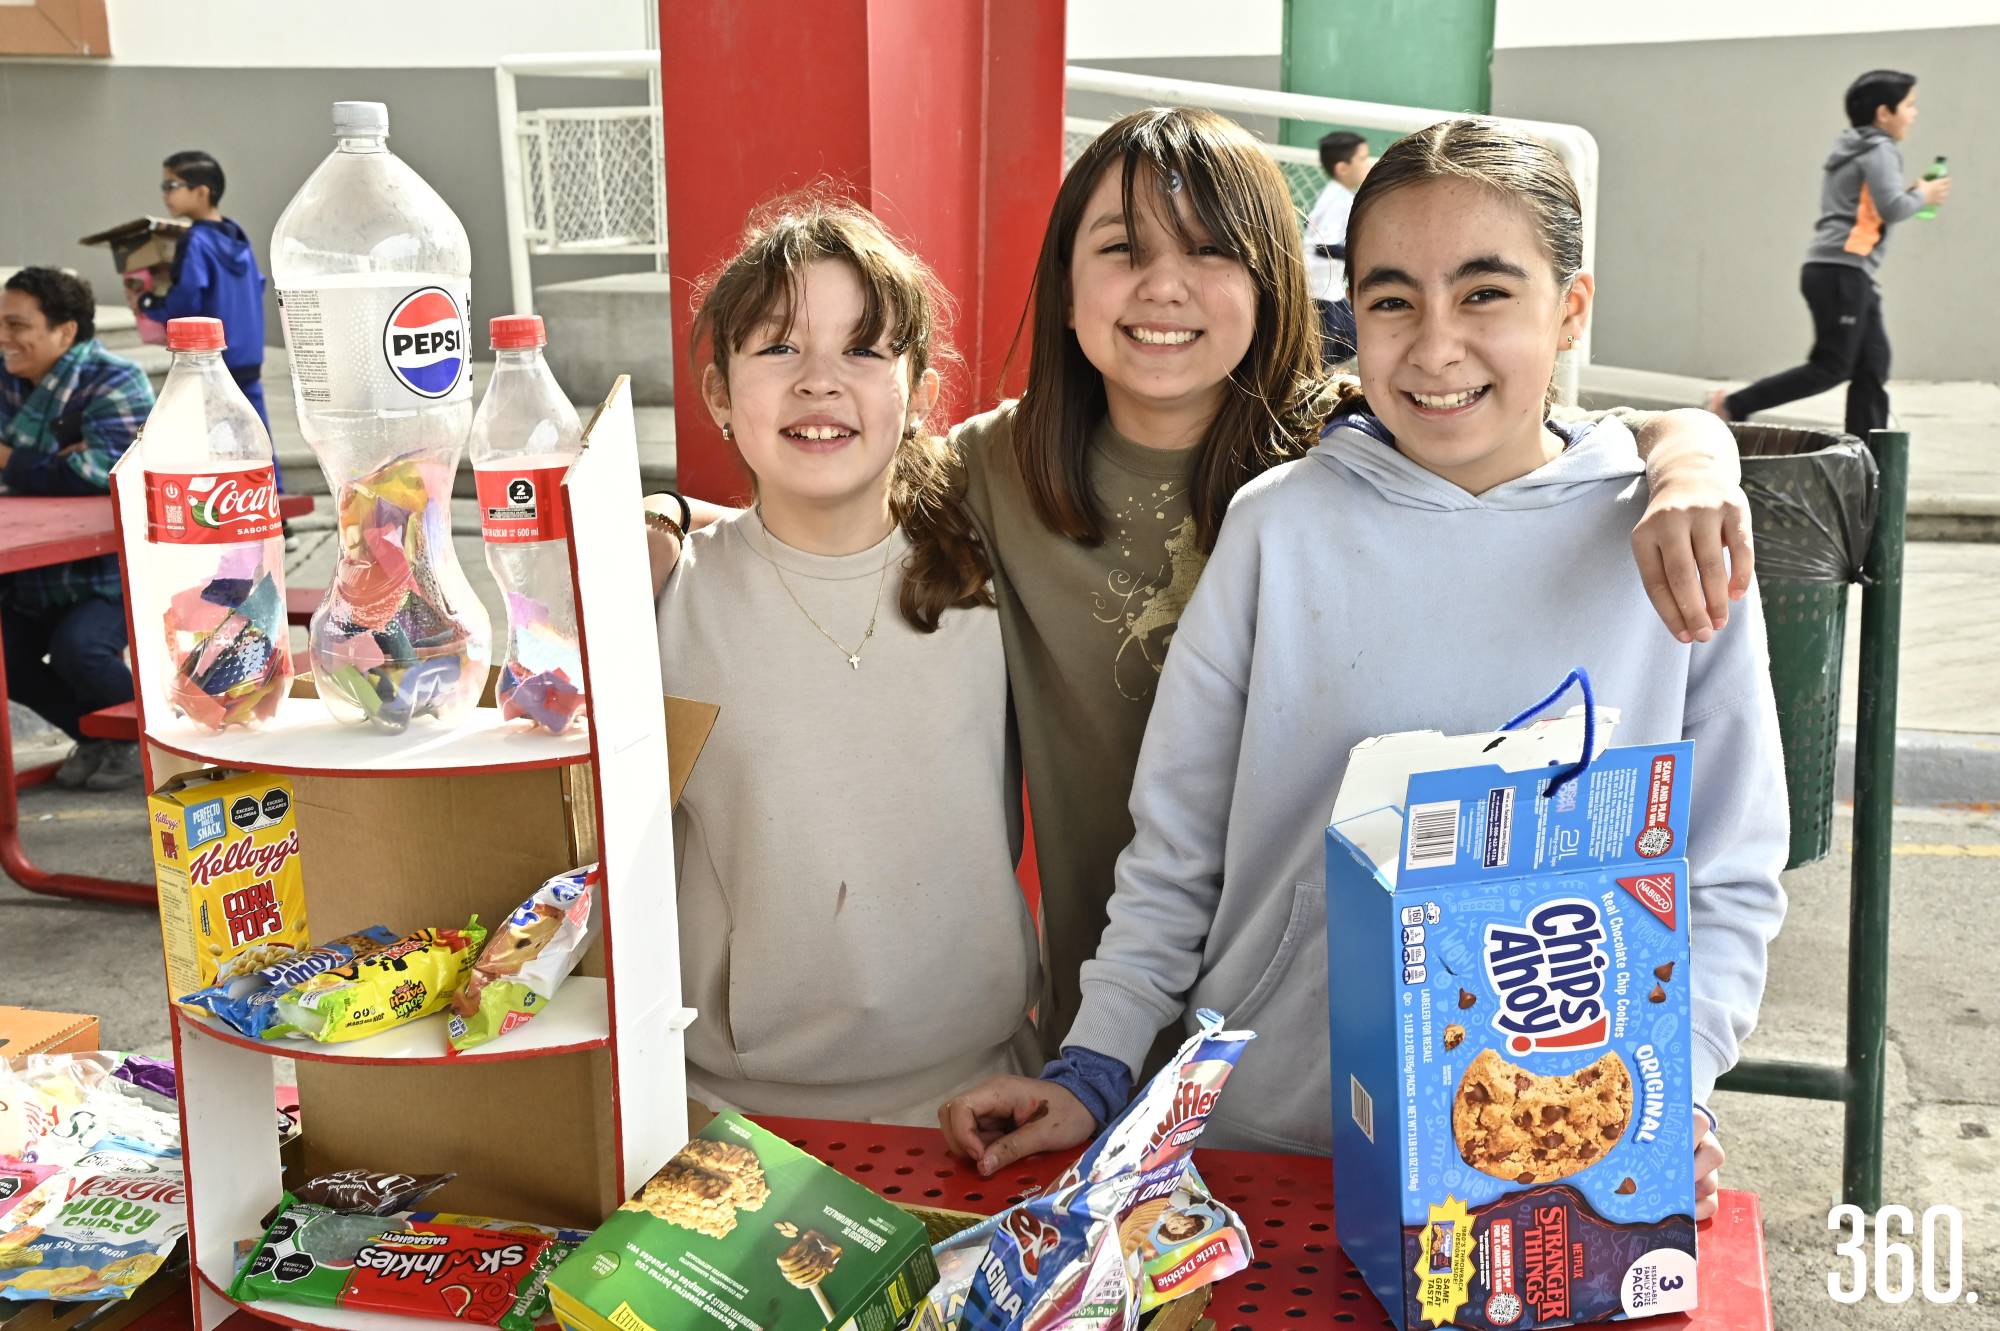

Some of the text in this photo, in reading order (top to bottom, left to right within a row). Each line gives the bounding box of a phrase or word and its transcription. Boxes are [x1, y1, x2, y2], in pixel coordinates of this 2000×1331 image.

[393, 330, 461, 356] PEPSI
[516, 485, 526, 496] 2
[237, 525, 268, 536] SABOR
[517, 528, 530, 537] 600
[1655, 760, 1663, 774] FOR
[1652, 780, 1661, 803] CHANCE
[1659, 785, 1669, 804] AND
[192, 801, 220, 825] PERFECTO
[1650, 804, 1658, 813] TO
[1657, 803, 1667, 822] PLAY
[1648, 813, 1657, 827] WIN
[197, 822, 222, 842] SNACK
[190, 830, 299, 886] Kellogg's
[222, 881, 274, 919] CORN
[1638, 881, 1670, 910] NABISCO
[229, 903, 282, 947] POPS
[1412, 908, 1422, 923] 160
[1532, 904, 1606, 1024] Chips
[1600, 890, 1630, 1039] Real Chocolate Chip Cookies
[390, 981, 427, 1007] PATCH
[395, 993, 425, 1017] SOUR
[1404, 1025, 1414, 1034] LB
[1420, 988, 1433, 1064] LABELED FOR RESALE
[1405, 1045, 1415, 1054] OZ
[1406, 1075, 1416, 1097] PACKS
[1634, 1044, 1665, 1143] ORIGINAL
[1407, 1105, 1417, 1118] NET
[1407, 1119, 1418, 1131] WT
[1408, 1138, 1418, 1147] LB
[1408, 1158, 1418, 1166] OZ
[63, 1216, 124, 1233] CHIPS
[1493, 1224, 1501, 1237] FOR
[29, 1240, 129, 1259] CON SAL DE MAR
[626, 1241, 640, 1254] ver.
[870, 1244, 881, 1254] LO
[1195, 1240, 1229, 1266] Little
[1494, 1244, 1502, 1269] CHANCE
[1502, 1249, 1511, 1267] AND
[639, 1250, 668, 1270] puedes
[1458, 1249, 1466, 1292] THROWBACK
[1524, 1226, 1545, 1305] THINGS
[1540, 1206, 1565, 1321] STRANGER
[1572, 1242, 1584, 1279] NETFLIX
[664, 1264, 680, 1280] que
[1157, 1256, 1197, 1287] Debbie
[1495, 1269, 1502, 1278] TO
[678, 1275, 708, 1298] simples
[1427, 1279, 1435, 1307] TASTE
[1434, 1277, 1443, 1307] GREAT
[1632, 1267, 1644, 1308] PACKS
[1650, 1265, 1658, 1305] RESEALABLE
[1659, 1275, 1684, 1292] 3
[634, 1259, 738, 1331] Hacemos nuestras barras con
[711, 1297, 732, 1314] REALES
